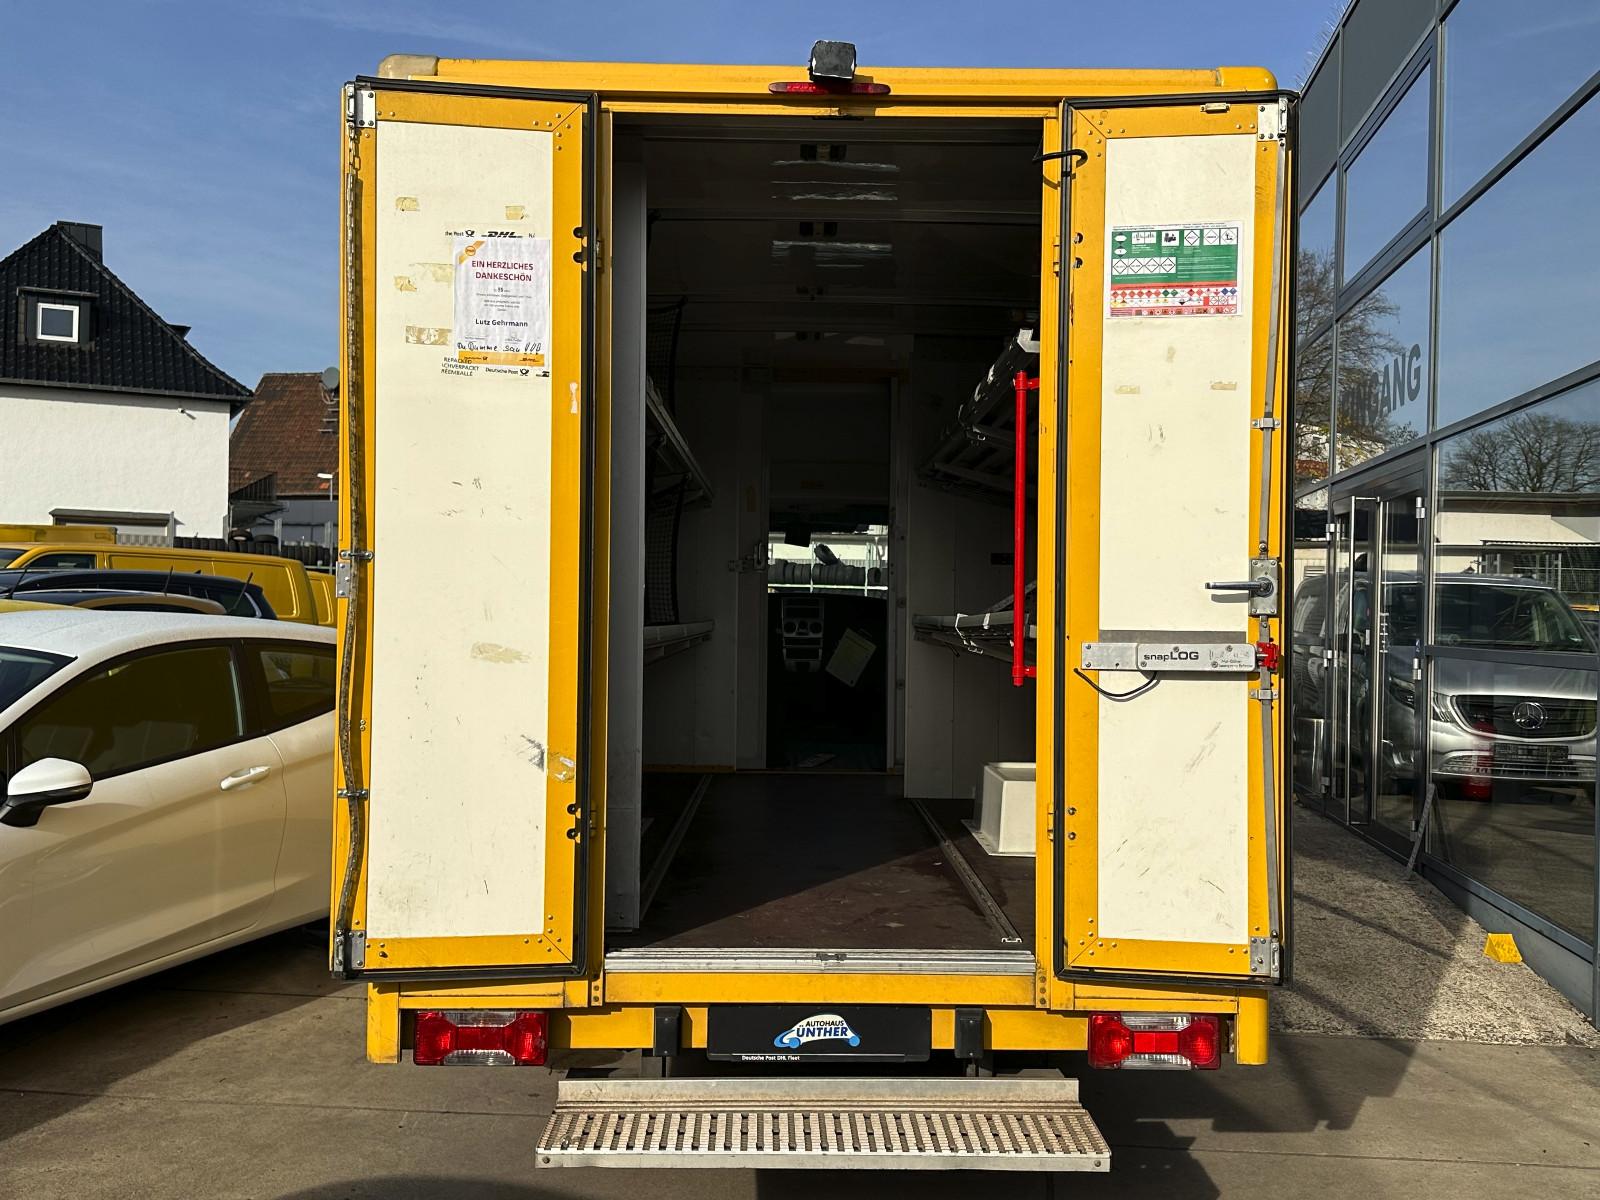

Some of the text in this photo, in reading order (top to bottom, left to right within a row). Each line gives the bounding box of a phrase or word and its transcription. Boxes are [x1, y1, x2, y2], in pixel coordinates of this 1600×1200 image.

[472, 260, 534, 271] EIN HERZLICHES
[475, 271, 532, 282] DANKESCHÖN
[475, 318, 528, 327] Lutz Gehrmann
[1143, 651, 1200, 662] snapLOG
[805, 1020, 845, 1028] AUTOHAUS
